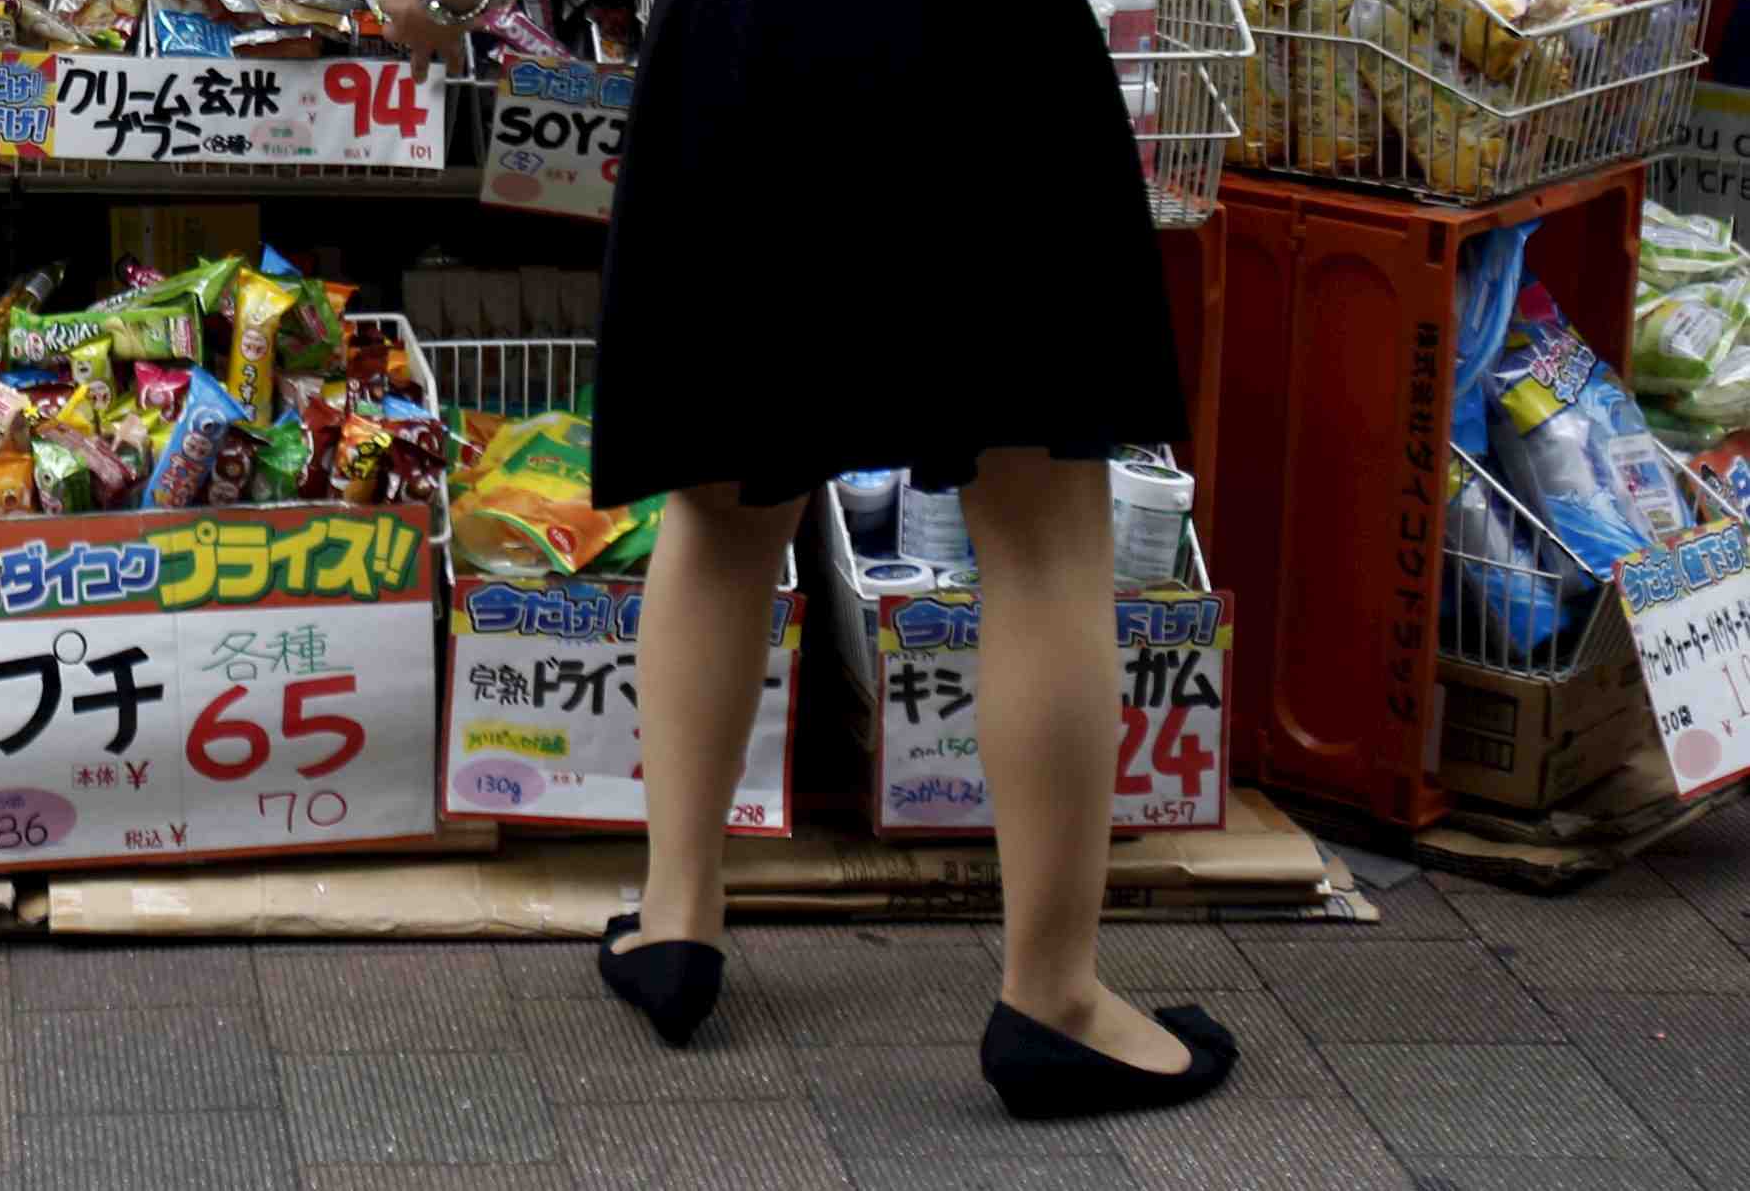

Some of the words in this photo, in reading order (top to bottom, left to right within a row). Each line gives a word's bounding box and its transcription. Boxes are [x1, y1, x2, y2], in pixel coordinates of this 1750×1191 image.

[57, 68, 281, 119] クリーム玄米
[324, 62, 429, 138] 94
[94, 114, 202, 161] ブラン
[410, 145, 433, 160] 101
[468, 583, 612, 640] 今だけ!
[201, 624, 356, 682] 各種
[75, 766, 117, 788] 本体
[186, 675, 366, 782] 65
[125, 829, 165, 850] 税込
[258, 790, 349, 834] 70
